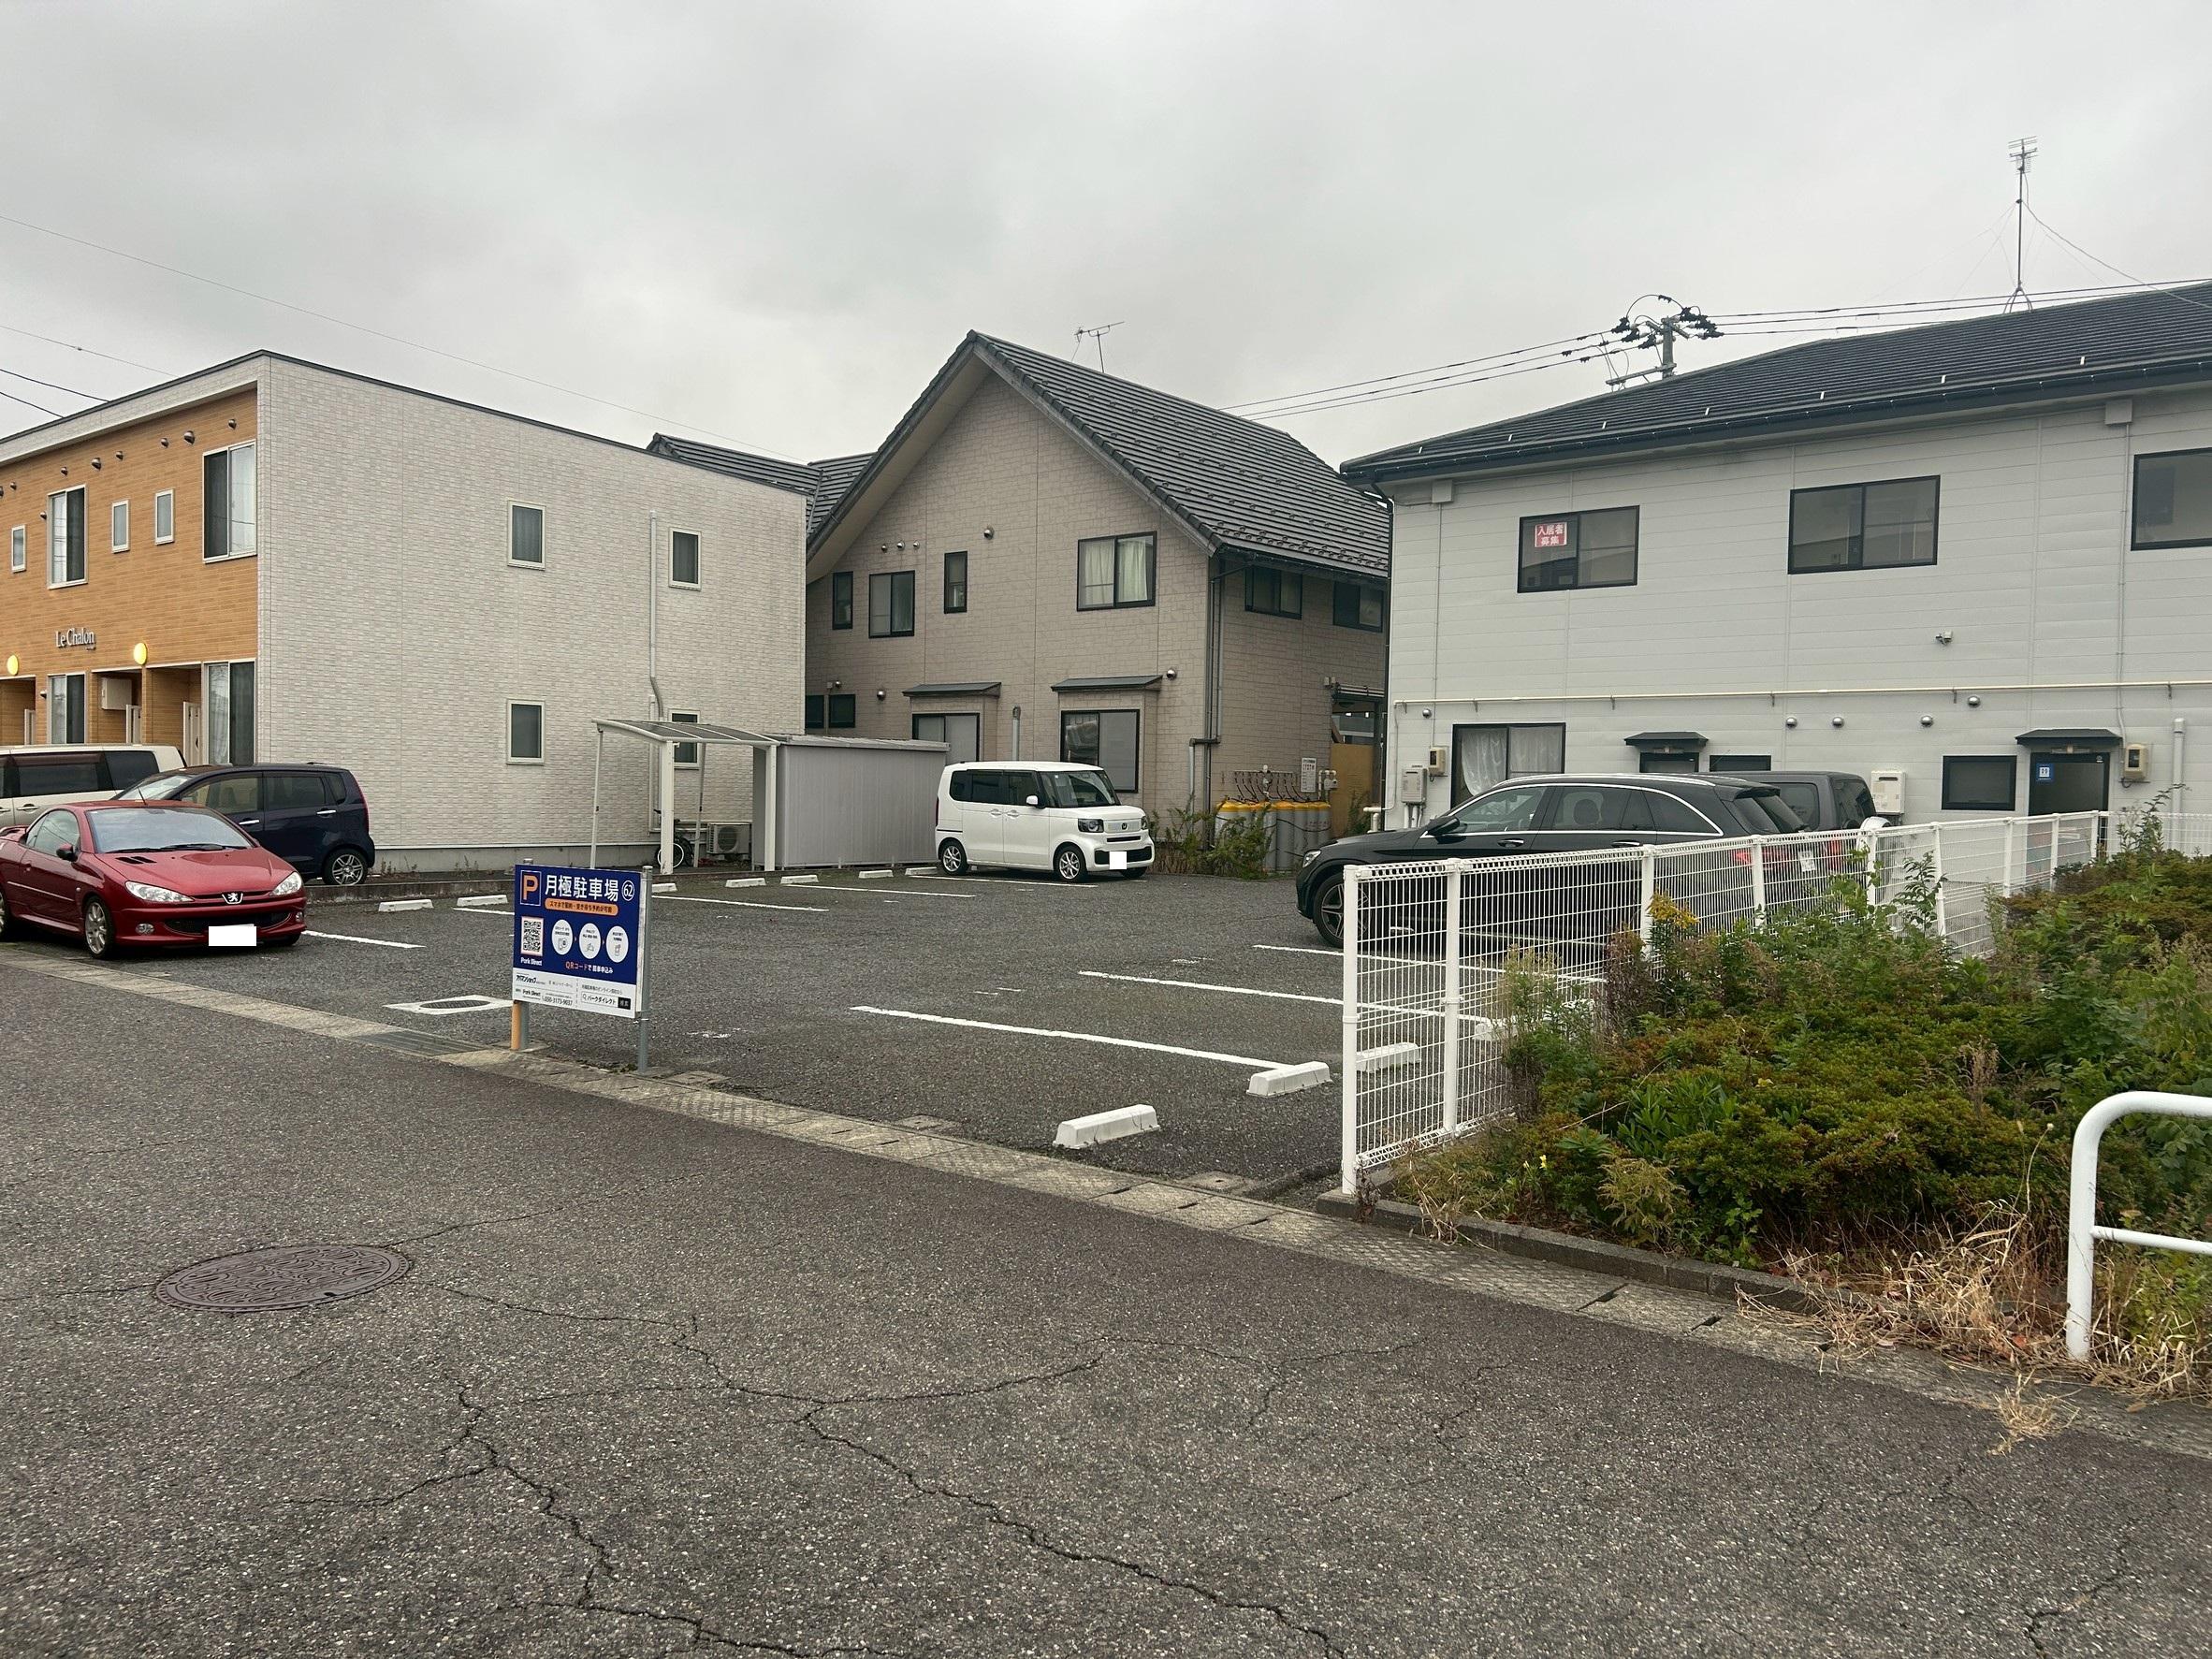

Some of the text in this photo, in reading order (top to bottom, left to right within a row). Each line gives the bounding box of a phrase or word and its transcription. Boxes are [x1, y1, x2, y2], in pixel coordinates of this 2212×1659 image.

[1537, 524, 1564, 536] 入居者
[55, 628, 95, 648] Le Chalon
[523, 874, 539, 901] P
[545, 874, 618, 902] 月極駐車場
[520, 956, 531, 965] Park
